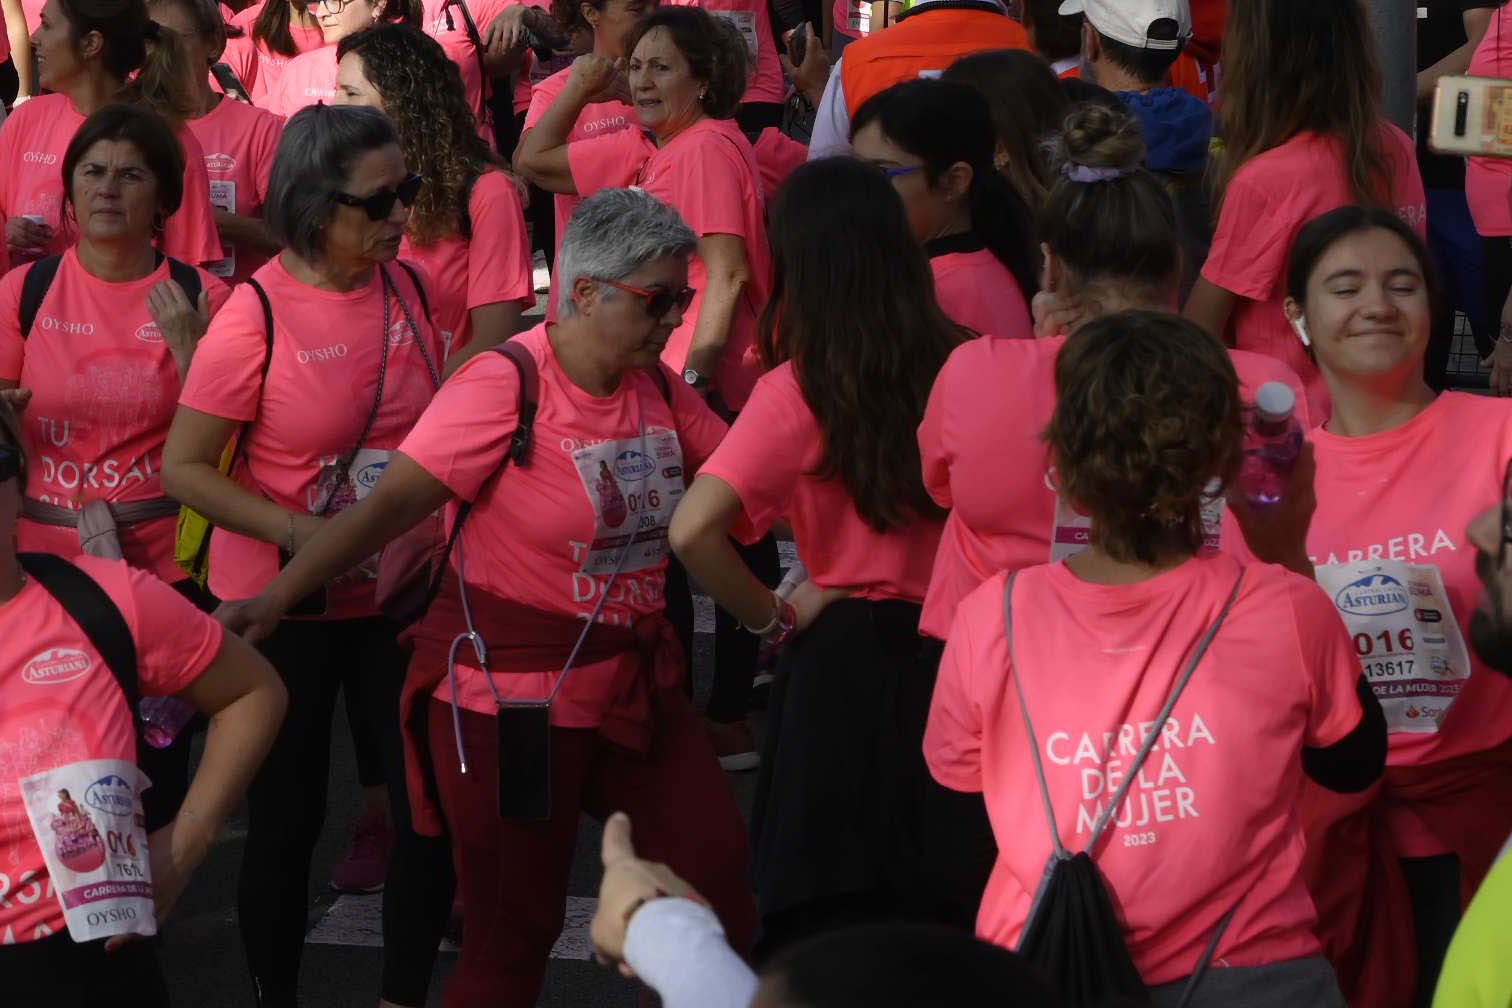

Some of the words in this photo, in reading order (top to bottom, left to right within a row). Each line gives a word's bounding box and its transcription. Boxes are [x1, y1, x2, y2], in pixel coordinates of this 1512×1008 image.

[583, 116, 625, 134] OYSHO
[41, 317, 94, 335] OYSHO
[297, 343, 348, 364] OYSHO
[38, 416, 70, 447] TU
[41, 454, 160, 489] DORSAL
[1353, 628, 1414, 656] 016
[1365, 660, 1415, 678] 13617
[1373, 686, 1389, 695] DE
[1390, 685, 1405, 694] LA
[1045, 712, 1216, 765] CARRERA
[1080, 765, 1122, 800] DE
[1138, 752, 1188, 788] LA
[1075, 786, 1200, 835] MUJER
[1123, 831, 1157, 848] 2023
[86, 906, 137, 927] OYSHO
